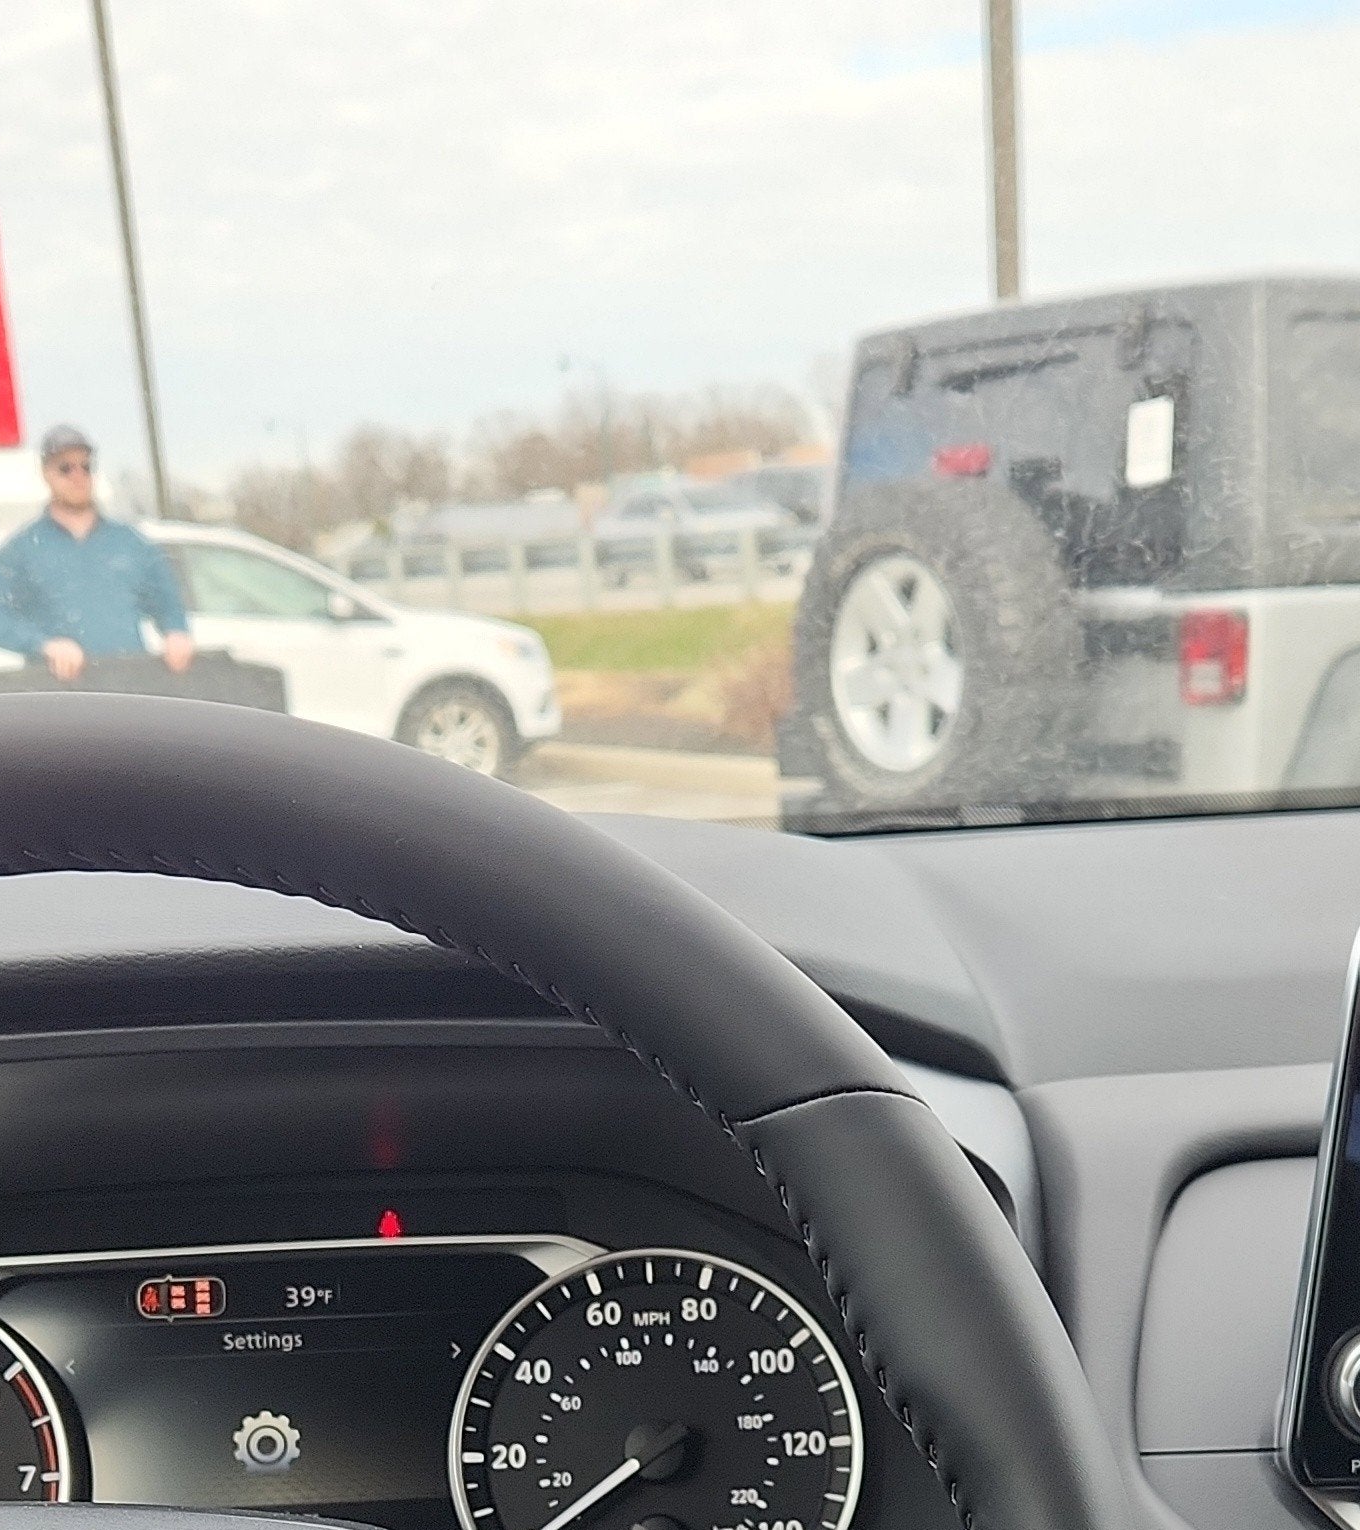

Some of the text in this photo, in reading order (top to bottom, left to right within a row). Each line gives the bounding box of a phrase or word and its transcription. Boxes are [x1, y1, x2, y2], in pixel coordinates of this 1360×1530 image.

[586, 1300, 622, 1327] 60
[632, 1311, 671, 1327] MPH
[681, 1297, 718, 1322] 80
[223, 1331, 304, 1352] Settings
[615, 1350, 642, 1366] 100
[693, 1358, 719, 1374] 140
[749, 1347, 795, 1375] 100
[514, 1358, 551, 1384] 40
[560, 1395, 582, 1412] 60
[737, 1414, 762, 1431] 180
[782, 1430, 827, 1457] 120
[491, 1443, 527, 1470] 20
[17, 1464, 37, 1492] 7
[552, 1472, 572, 1487] 20
[730, 1488, 759, 1505] 220
